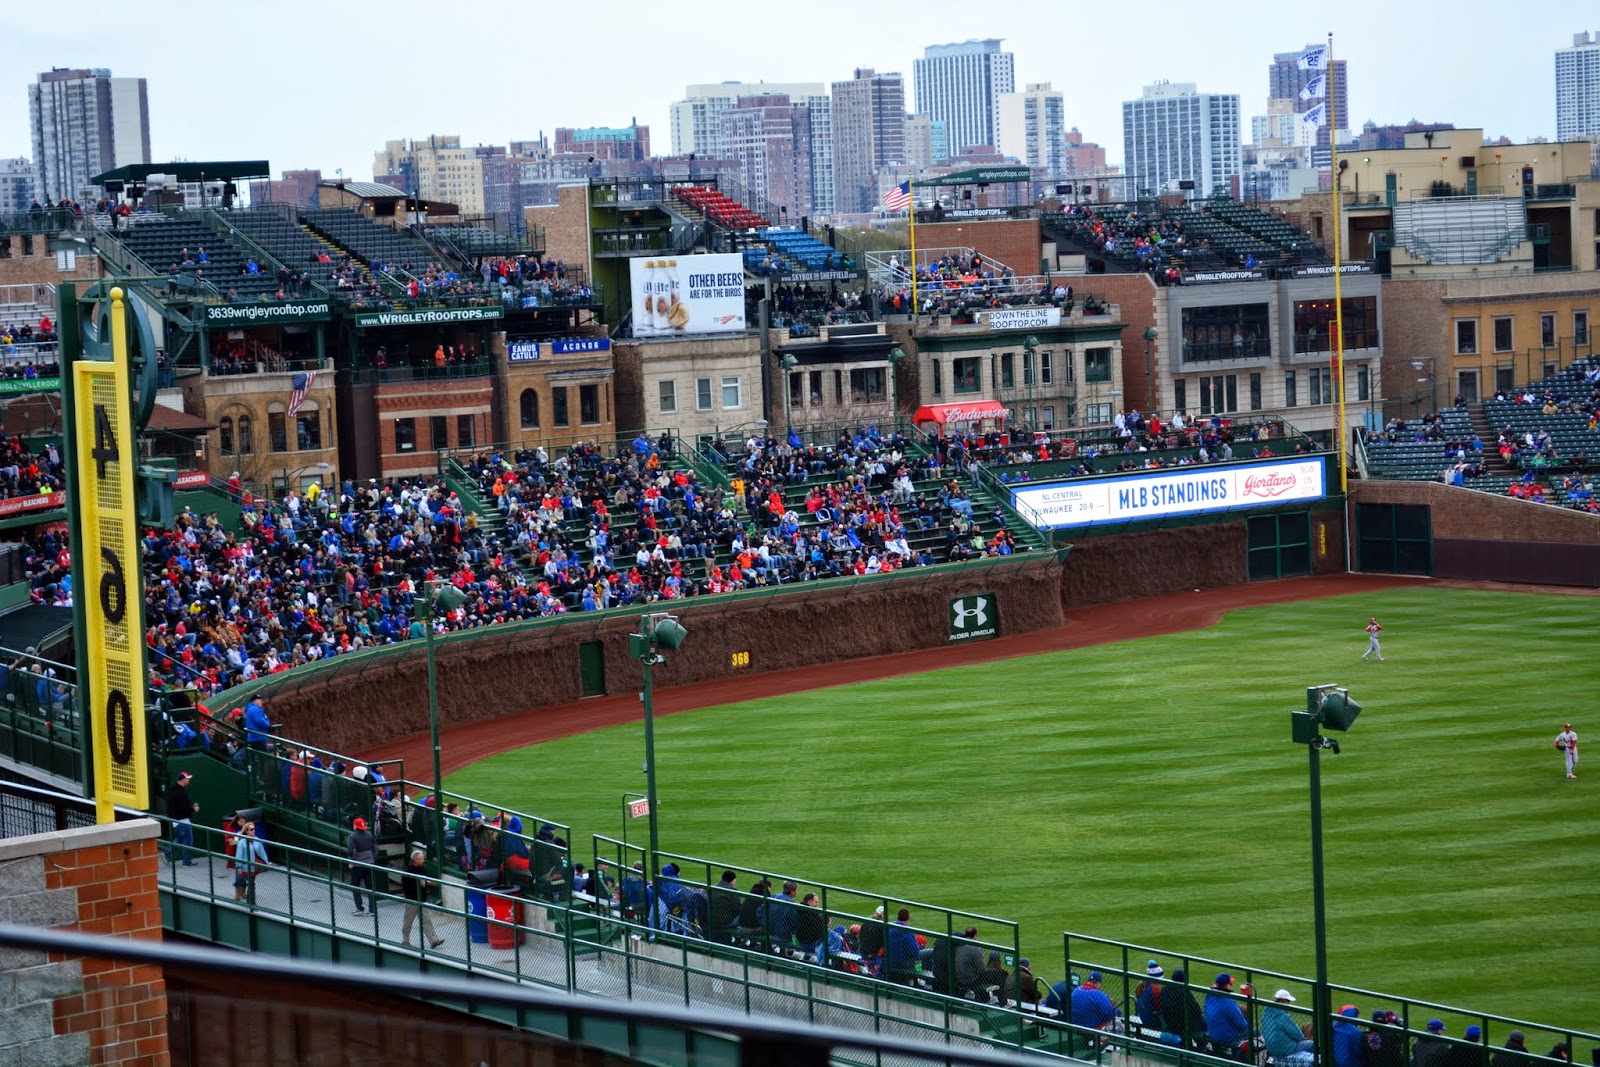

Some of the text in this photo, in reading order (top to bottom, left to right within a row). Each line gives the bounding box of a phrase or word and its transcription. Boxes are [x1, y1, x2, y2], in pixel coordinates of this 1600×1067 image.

[979, 169, 1029, 180] wrigleyrooftops.com
[1297, 265, 1370, 275] www.WRIGLEYROFTOPS.com
[689, 272, 743, 288] OTHER BEERS
[654, 283, 669, 294] Lite
[690, 287, 743, 299] ARE FOR THE BIRDS.
[208, 303, 328, 319] 3639wrigleyrooftop.com
[990, 319, 1048, 329] ROOFTOP.COM
[512, 345, 536, 353] EAMUS
[943, 407, 1010, 423] Budweiser
[1243, 472, 1297, 496] Giordano's
[1042, 490, 1082, 501] NL CENTRAL
[1119, 478, 1227, 509] MLB STANDINGS
[970, 628, 995, 637] ARMOUR
[732, 651, 749, 666] 368
[633, 803, 647, 816] EXIT
